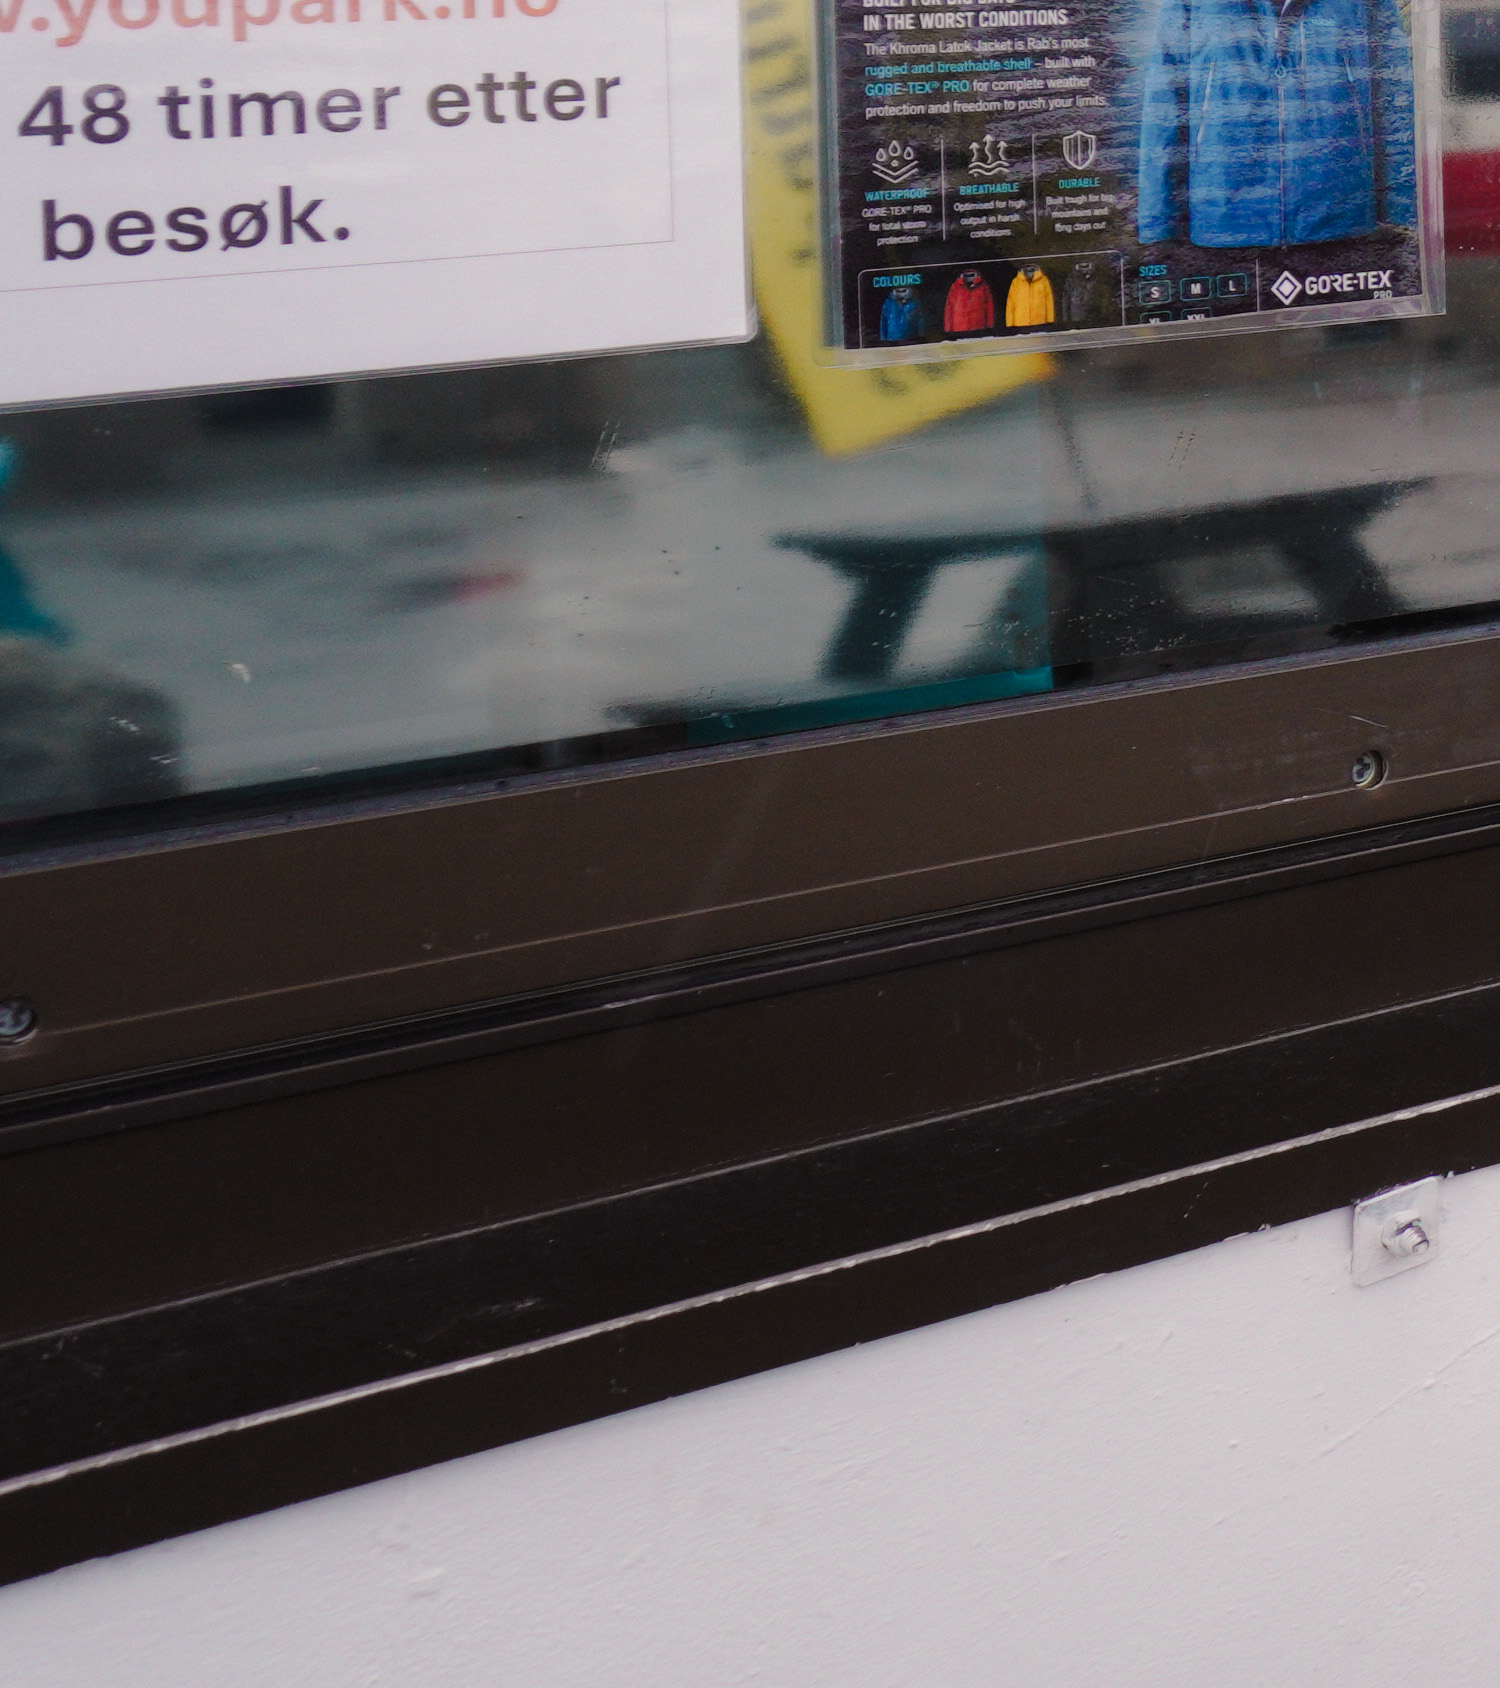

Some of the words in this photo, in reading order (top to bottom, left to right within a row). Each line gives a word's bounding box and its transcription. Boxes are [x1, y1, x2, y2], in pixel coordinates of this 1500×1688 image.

[863, 14, 880, 31] IN
[884, 13, 916, 30] THE
[919, 11, 976, 29] WORST
[978, 9, 1068, 26] CONDITIONS
[864, 42, 887, 56] The
[889, 41, 936, 55] Khroma
[938, 41, 972, 54] Latok
[974, 39, 1012, 53] Jacket
[1014, 39, 1025, 50] is
[1027, 37, 1059, 50] Rab's
[1060, 36, 1091, 49] most
[864, 65, 909, 78] rugged
[911, 62, 936, 75] and
[937, 60, 1001, 74] breathable
[1003, 56, 1033, 70] shell
[1044, 55, 1070, 69] built
[1071, 54, 1097, 68] with
[942, 79, 971, 94] PRO
[972, 78, 989, 92] for
[991, 78, 1045, 92] complete
[1046, 75, 1092, 90] weather
[17, 83, 131, 147] 48
[157, 77, 401, 140] timer
[425, 69, 622, 128] etter
[865, 102, 925, 120] protection
[927, 100, 951, 115] and
[953, 98, 1002, 113] freedom
[1004, 99, 1015, 111] to
[1018, 96, 1047, 113] push
[1048, 95, 1074, 111] your
[864, 188, 931, 202] WATERPROOF
[958, 181, 1021, 196] BREATHABLE
[1057, 176, 1101, 190] DURABLE
[913, 204, 933, 216] PRO
[41, 184, 351, 262] besøk.
[876, 234, 919, 247] protection
[872, 273, 923, 288] COLOURS
[1138, 264, 1169, 277] SIZES
[1151, 286, 1160, 299] S
[1190, 282, 1202, 296] M
[1228, 279, 1237, 293] L
